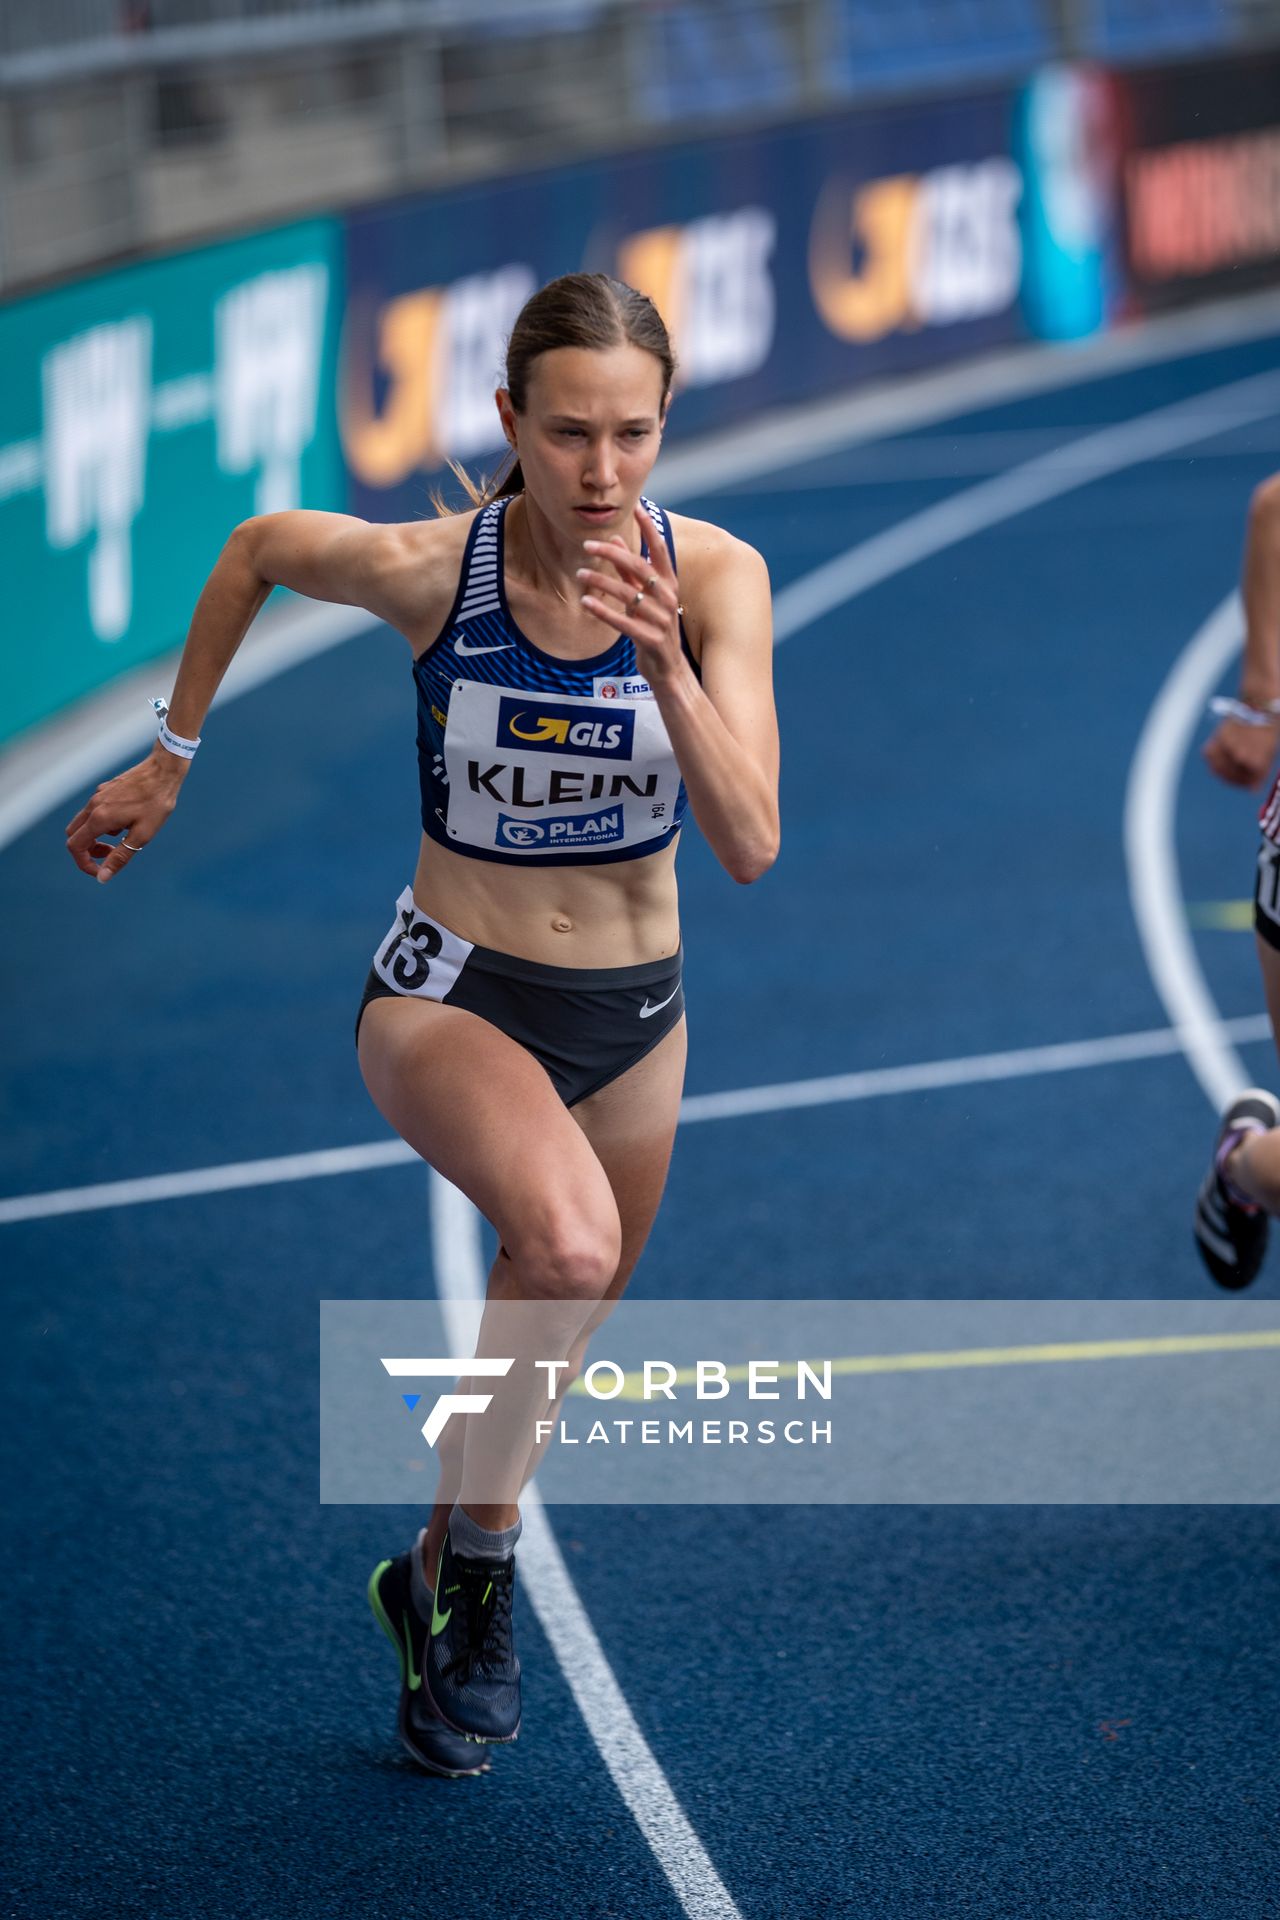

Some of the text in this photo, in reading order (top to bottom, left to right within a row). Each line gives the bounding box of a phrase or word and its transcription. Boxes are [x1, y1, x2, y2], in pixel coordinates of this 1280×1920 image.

[569, 721, 623, 749] GLS
[467, 760, 658, 808] KLEIN
[651, 802, 666, 819] 164
[549, 812, 619, 838] PLAN
[549, 831, 619, 845] INTERNATIONAL
[381, 909, 443, 991] 13
